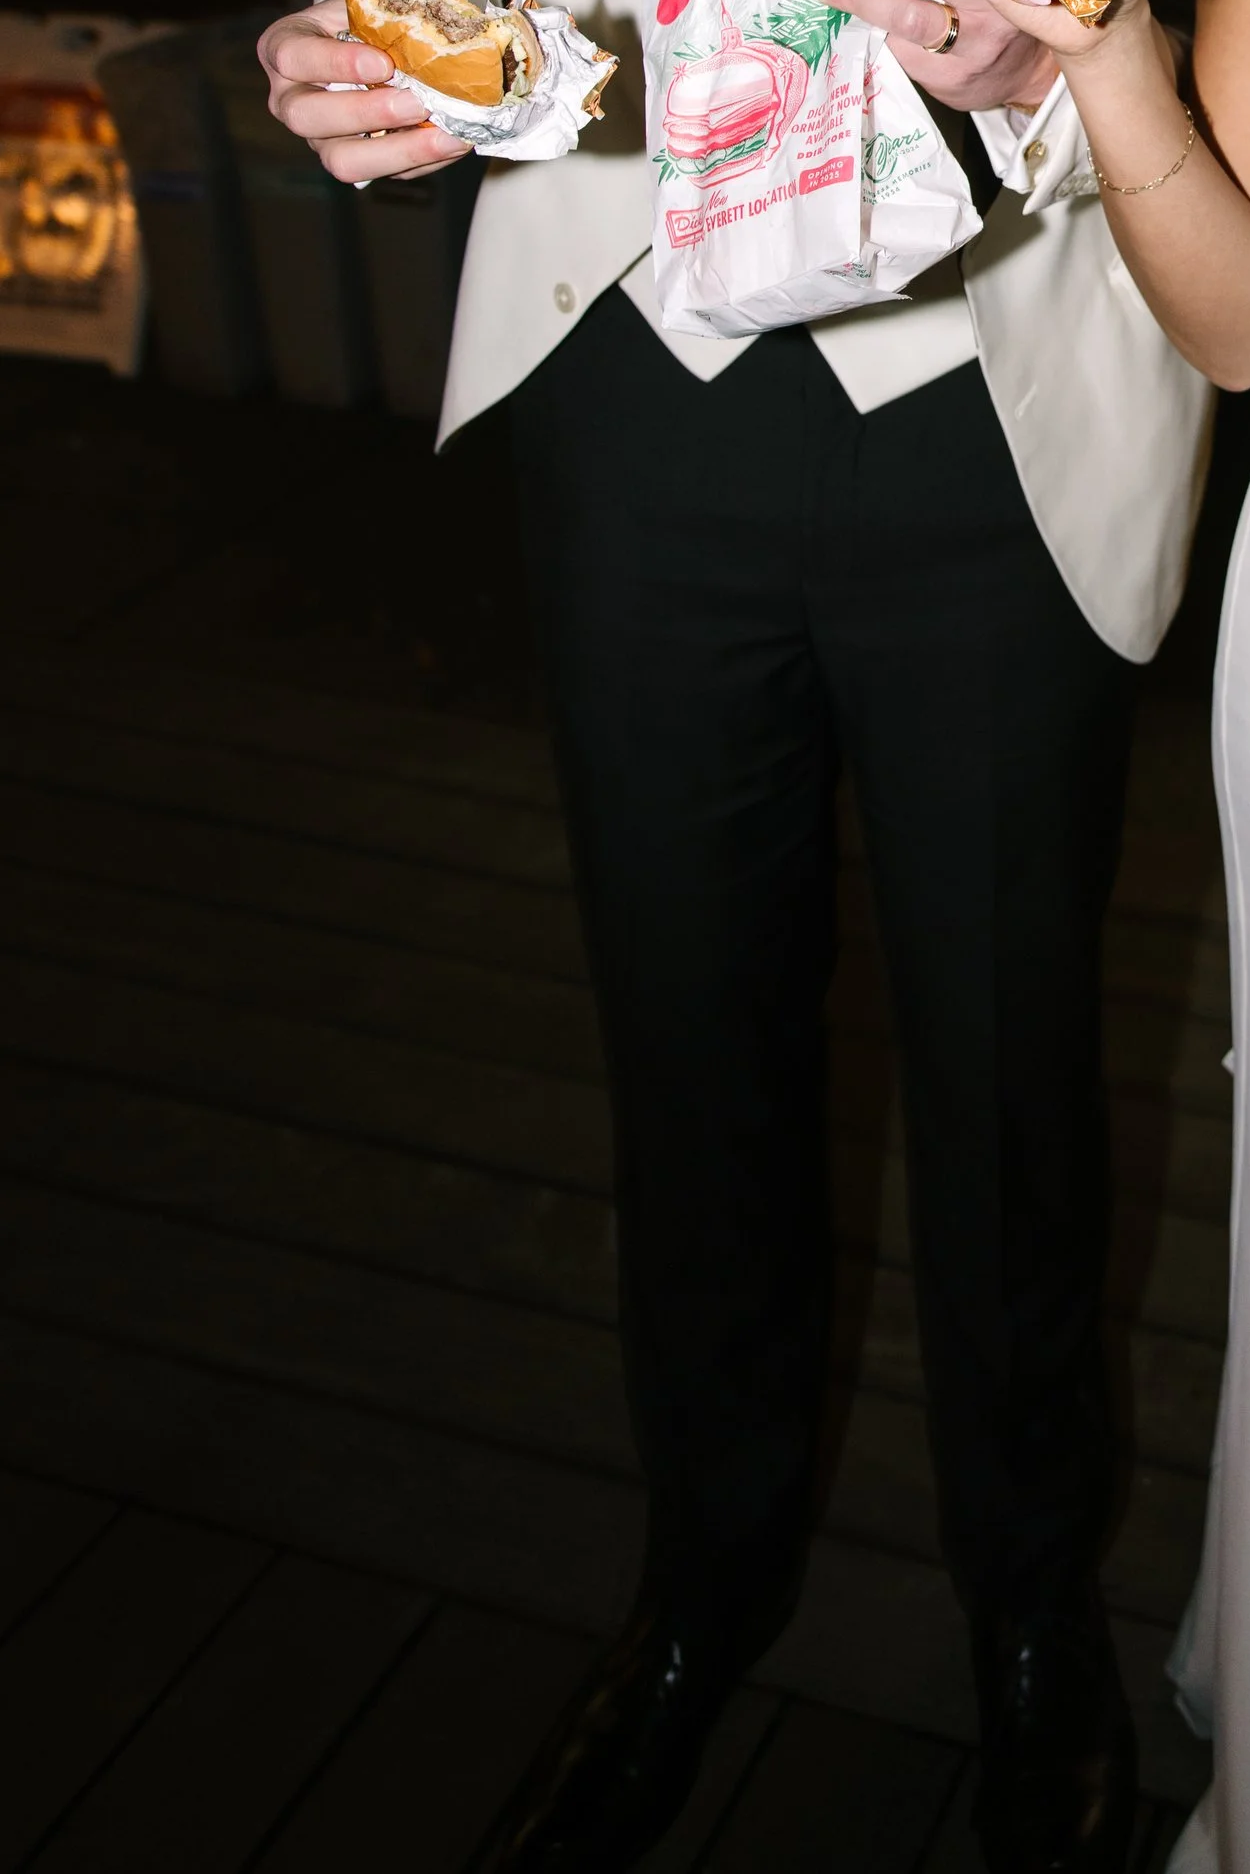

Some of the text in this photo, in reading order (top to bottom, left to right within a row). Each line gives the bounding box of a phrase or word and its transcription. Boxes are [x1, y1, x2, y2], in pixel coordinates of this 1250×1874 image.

[829, 82, 851, 103] NEW
[836, 94, 863, 113] NOW
[820, 171, 840, 183] 2025
[892, 162, 932, 186] MEMORIES
[703, 189, 729, 214] New
[705, 204, 745, 233] EVERETT
